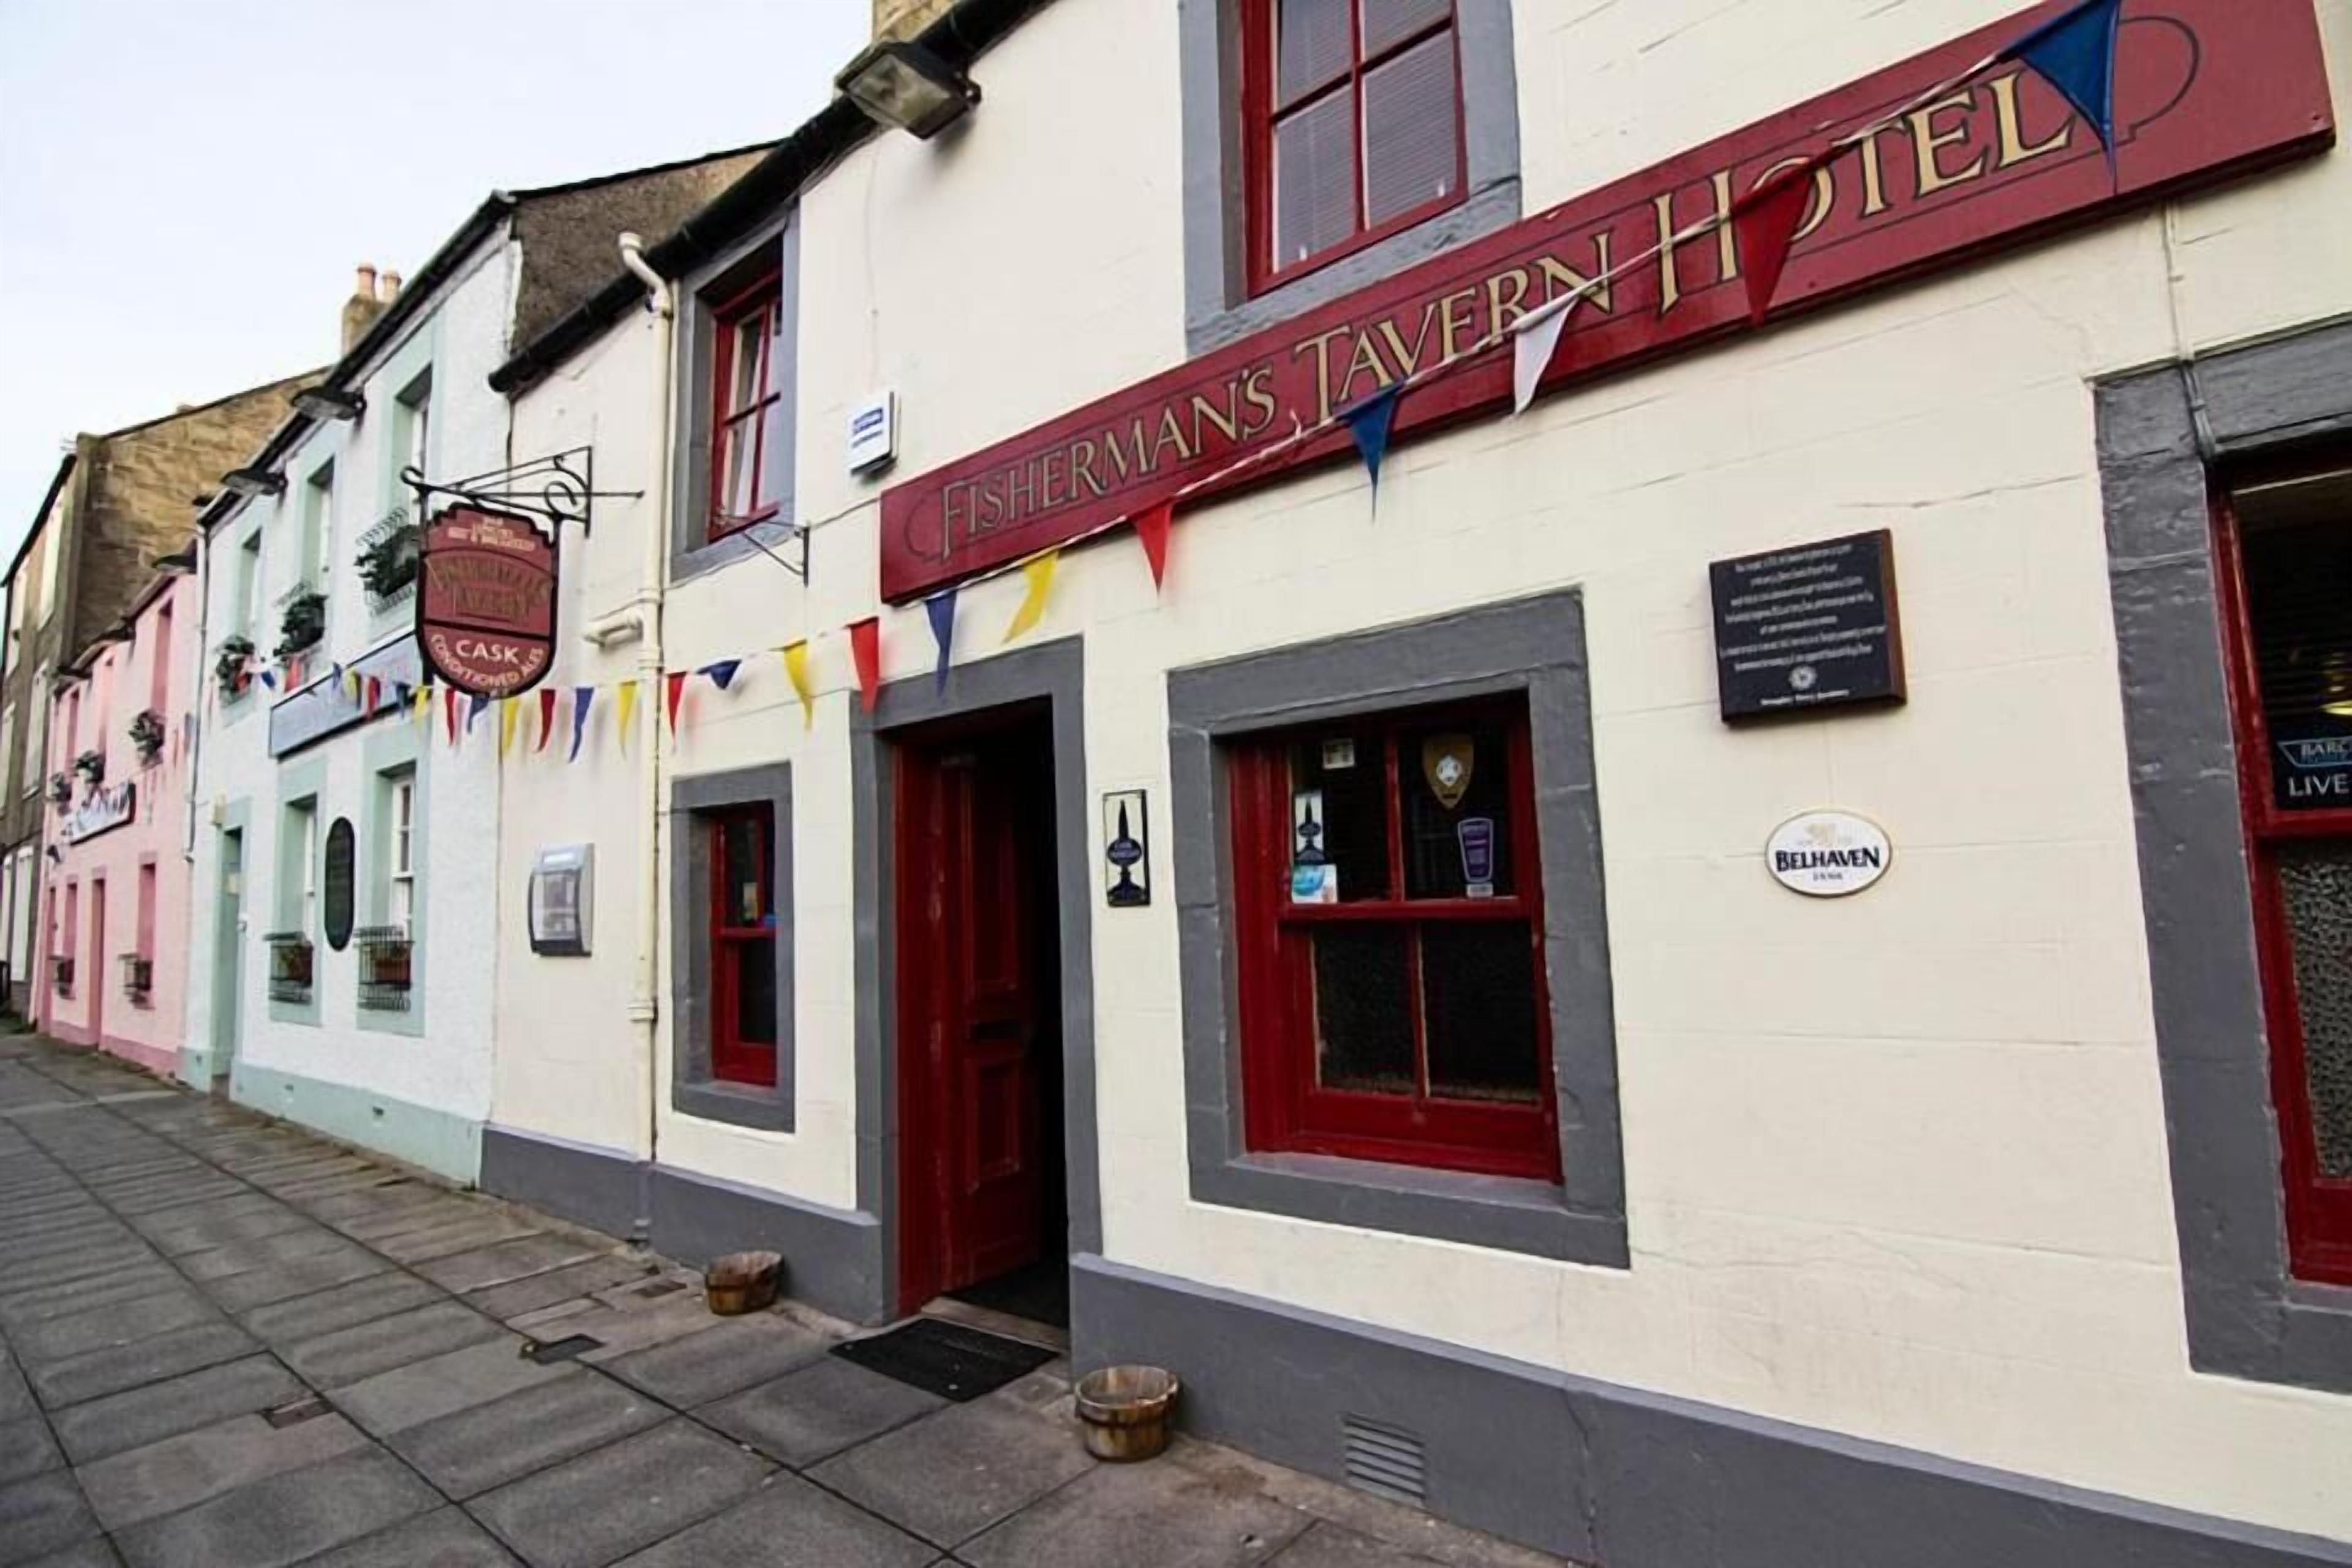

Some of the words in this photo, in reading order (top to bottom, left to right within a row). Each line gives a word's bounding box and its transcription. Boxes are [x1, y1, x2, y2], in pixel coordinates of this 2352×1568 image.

[1294, 226, 1615, 426] TAVERN
[1653, 69, 2077, 318] HOTEL
[455, 639, 520, 665] CASK
[2288, 773, 2350, 797] LIVE
[1775, 846, 1880, 872] BELHAVEN
